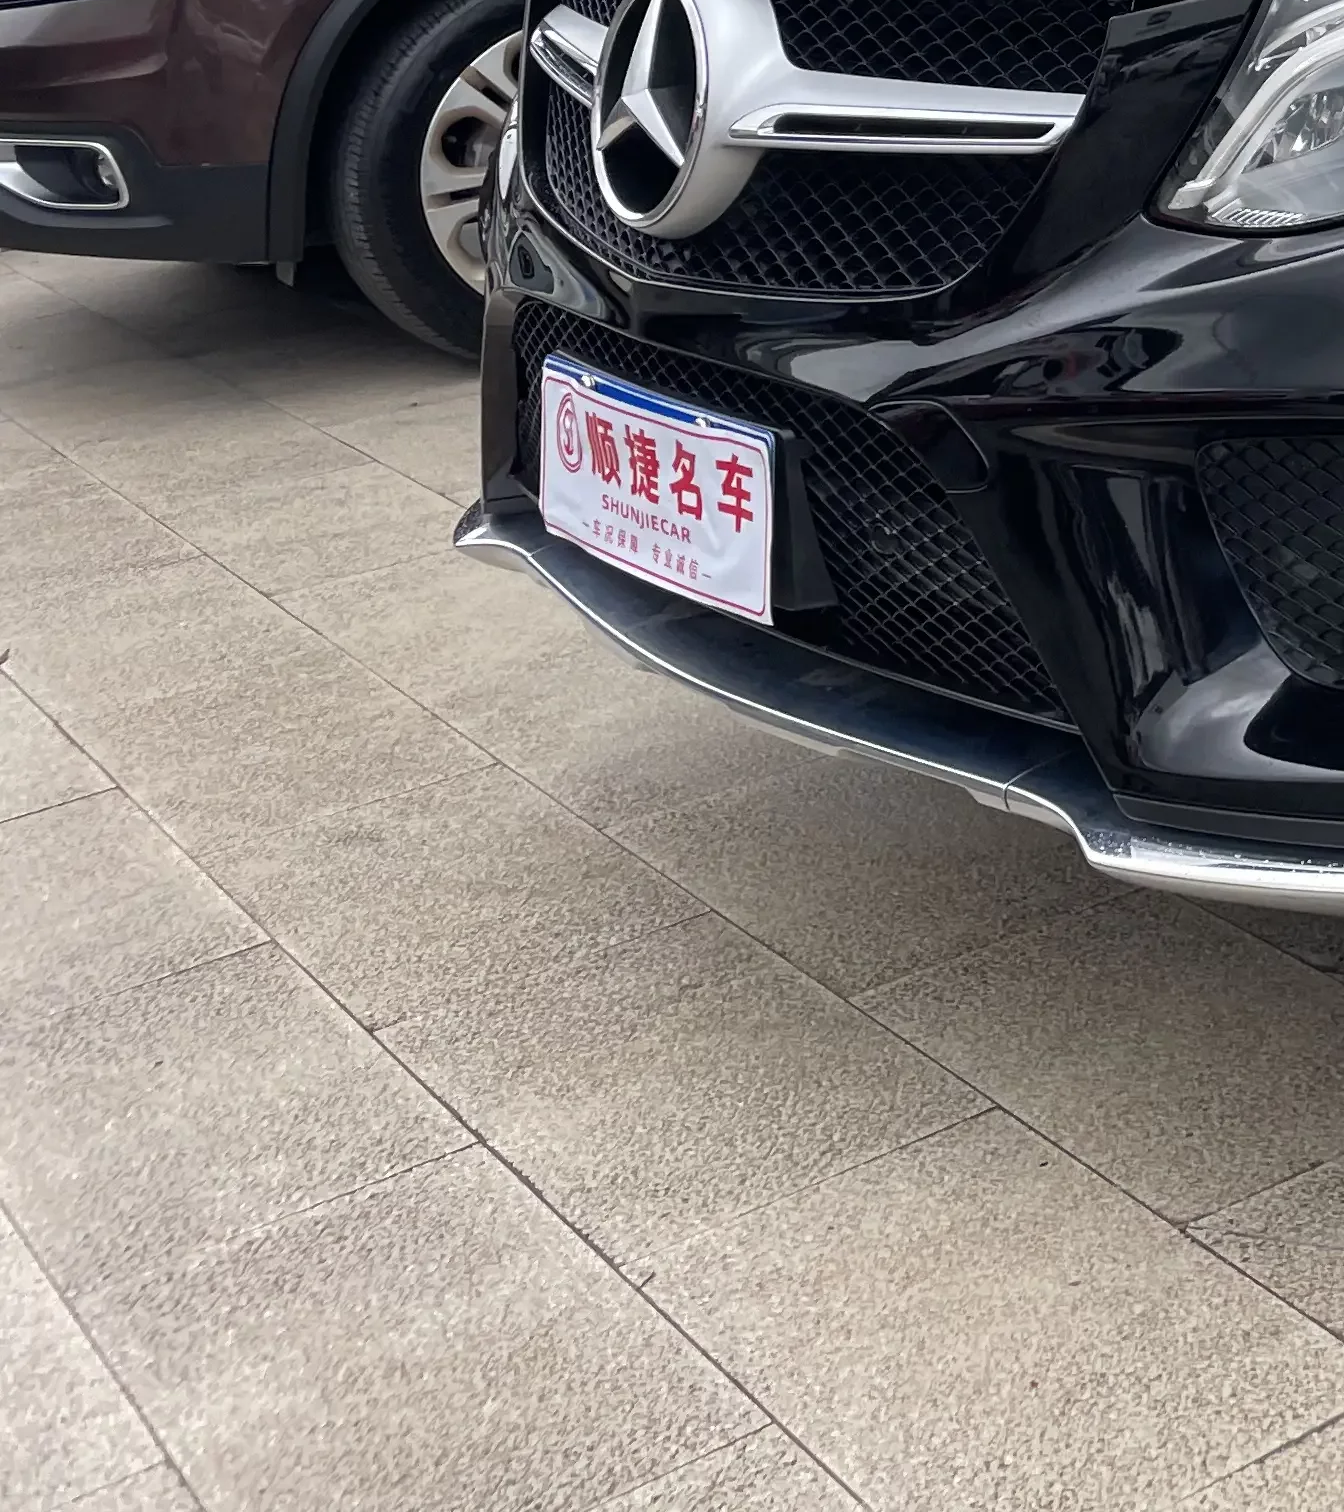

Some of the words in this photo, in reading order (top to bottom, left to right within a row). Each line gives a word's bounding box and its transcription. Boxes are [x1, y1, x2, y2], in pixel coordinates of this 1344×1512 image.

[585, 411, 754, 533] 顺捷名车
[602, 493, 692, 544] SHUNJIECAR
